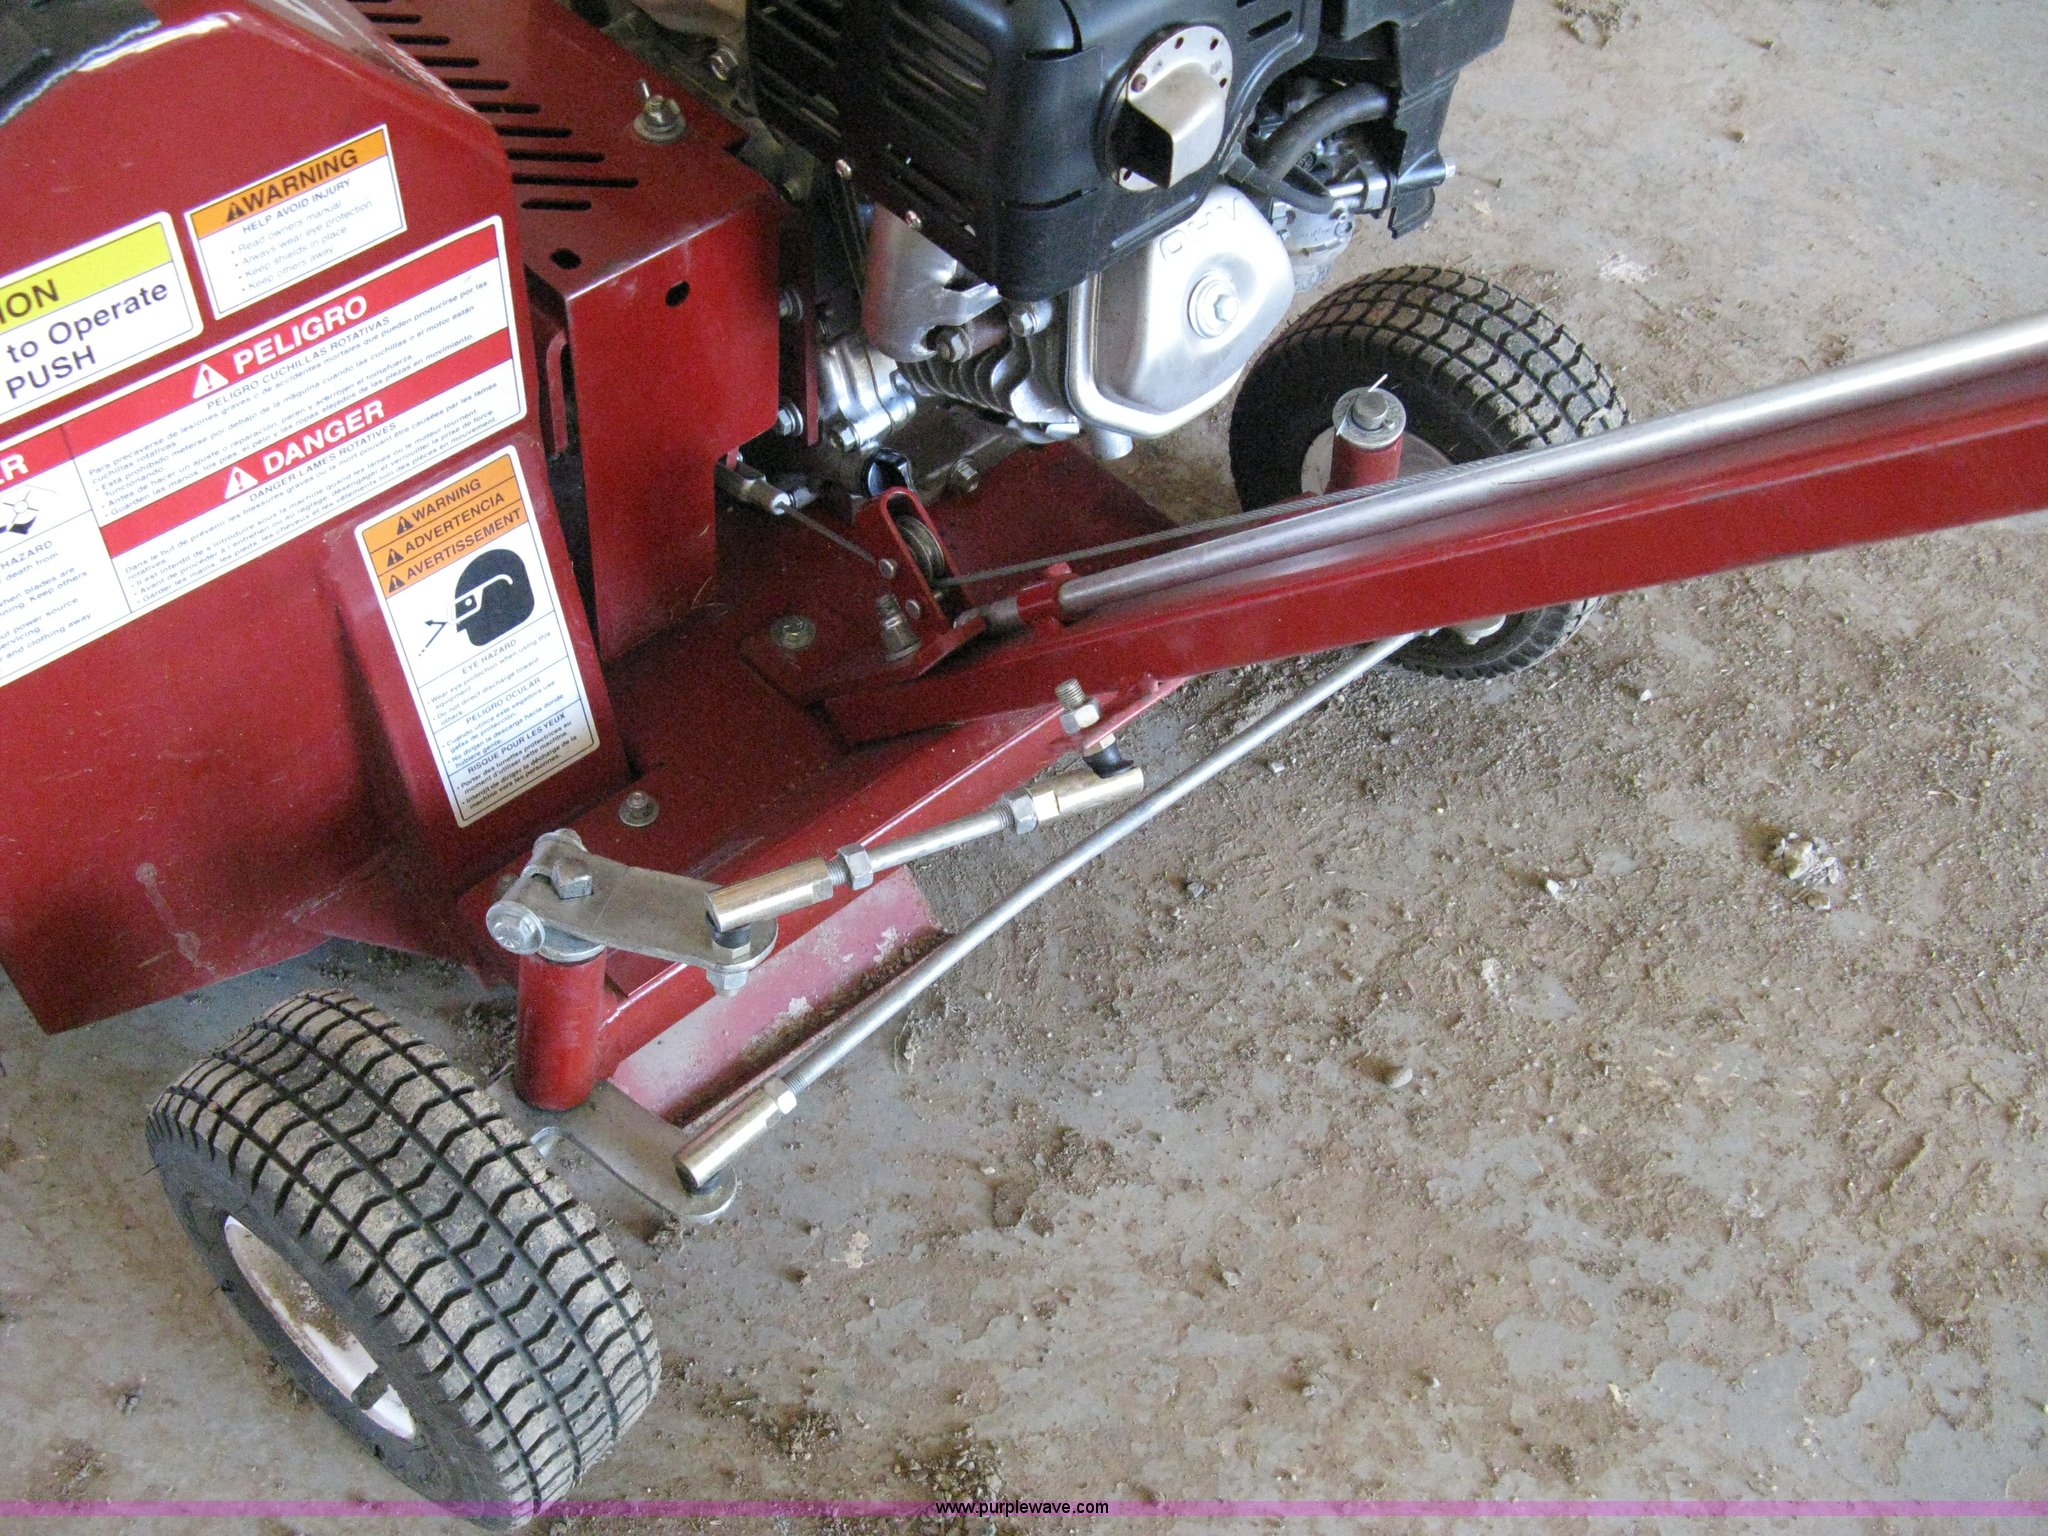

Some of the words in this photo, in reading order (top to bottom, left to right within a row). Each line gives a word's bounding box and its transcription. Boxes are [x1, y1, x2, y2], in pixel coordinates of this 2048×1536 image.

[242, 149, 357, 211] WARNING
[242, 214, 271, 233] HELP
[276, 198, 308, 218] AVOID
[311, 179, 349, 202] INJURY
[238, 236, 264, 251] Read
[268, 219, 303, 239] owners
[306, 200, 341, 220] manual
[242, 246, 276, 263] Always
[279, 233, 302, 248] wear
[305, 224, 322, 236] eye
[325, 200, 372, 228] protection
[244, 262, 270, 277] Keep
[273, 245, 307, 265] shields
[309, 239, 319, 248] in
[321, 226, 346, 243] place
[1159, 196, 1241, 262] OHV
[248, 274, 273, 288] Keep
[277, 259, 307, 277] others
[310, 247, 333, 262] away
[6, 341, 39, 364] to
[48, 283, 168, 342] Operate
[232, 294, 369, 375] PELIGRO
[6, 345, 96, 400] PUSH
[207, 380, 258, 409] PELIGRO
[262, 347, 327, 383] CUCHILLAS
[330, 316, 389, 350] ROTATIVAS
[249, 473, 295, 501] DANGER
[298, 453, 336, 476] LAMES
[338, 422, 396, 455] ROTATIVES
[262, 399, 386, 479] DANGER
[0, 453, 29, 487] R
[411, 478, 481, 521] WARNING
[406, 492, 504, 553] ADVERTENCIA
[407, 507, 519, 578] AVERTISSEMENT
[0, 540, 52, 569] HAZARD
[461, 661, 477, 674] EYE
[481, 639, 516, 663] HAZARD
[465, 699, 503, 724] PELIGRO
[505, 677, 540, 701] OCULAR
[467, 752, 499, 773] RISQUE
[500, 736, 525, 754] POUR
[526, 726, 543, 739] LES
[543, 712, 565, 728] YEUX
